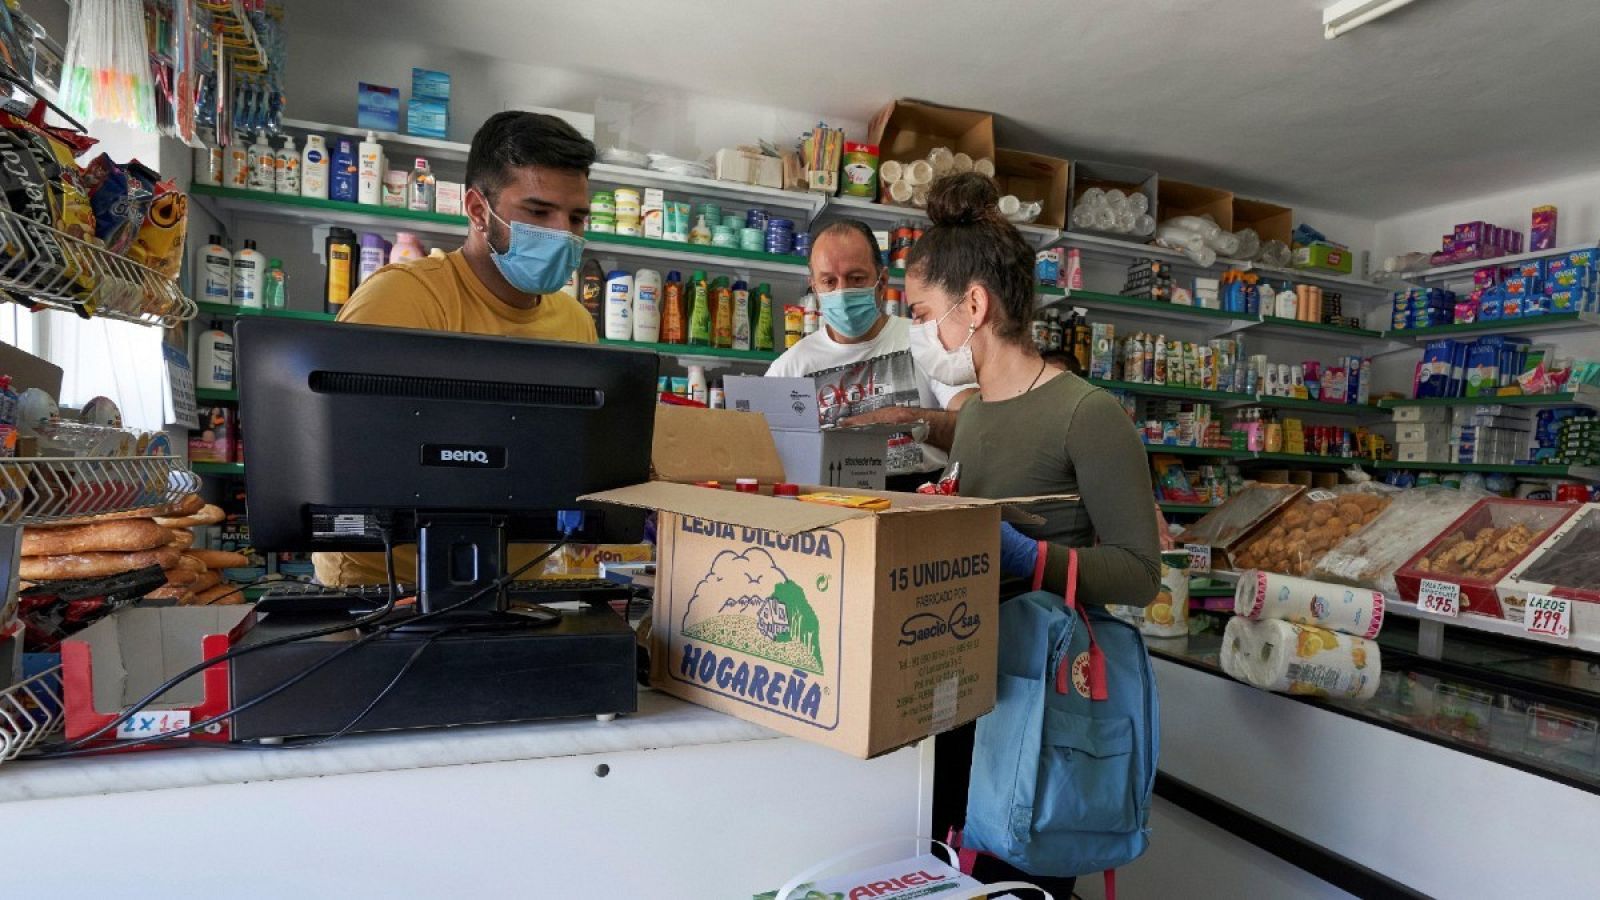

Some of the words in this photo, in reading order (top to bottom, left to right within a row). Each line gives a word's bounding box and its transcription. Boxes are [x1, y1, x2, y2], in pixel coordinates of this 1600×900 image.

[889, 567, 908, 592] 15
[913, 553, 990, 588] UNIDADES
[916, 590, 952, 609] FABRICADO
[954, 587, 968, 600] POR
[1529, 596, 1567, 613] LAZOS
[681, 643, 822, 720] HOGAREÑA
[849, 870, 945, 900] ARIEL
